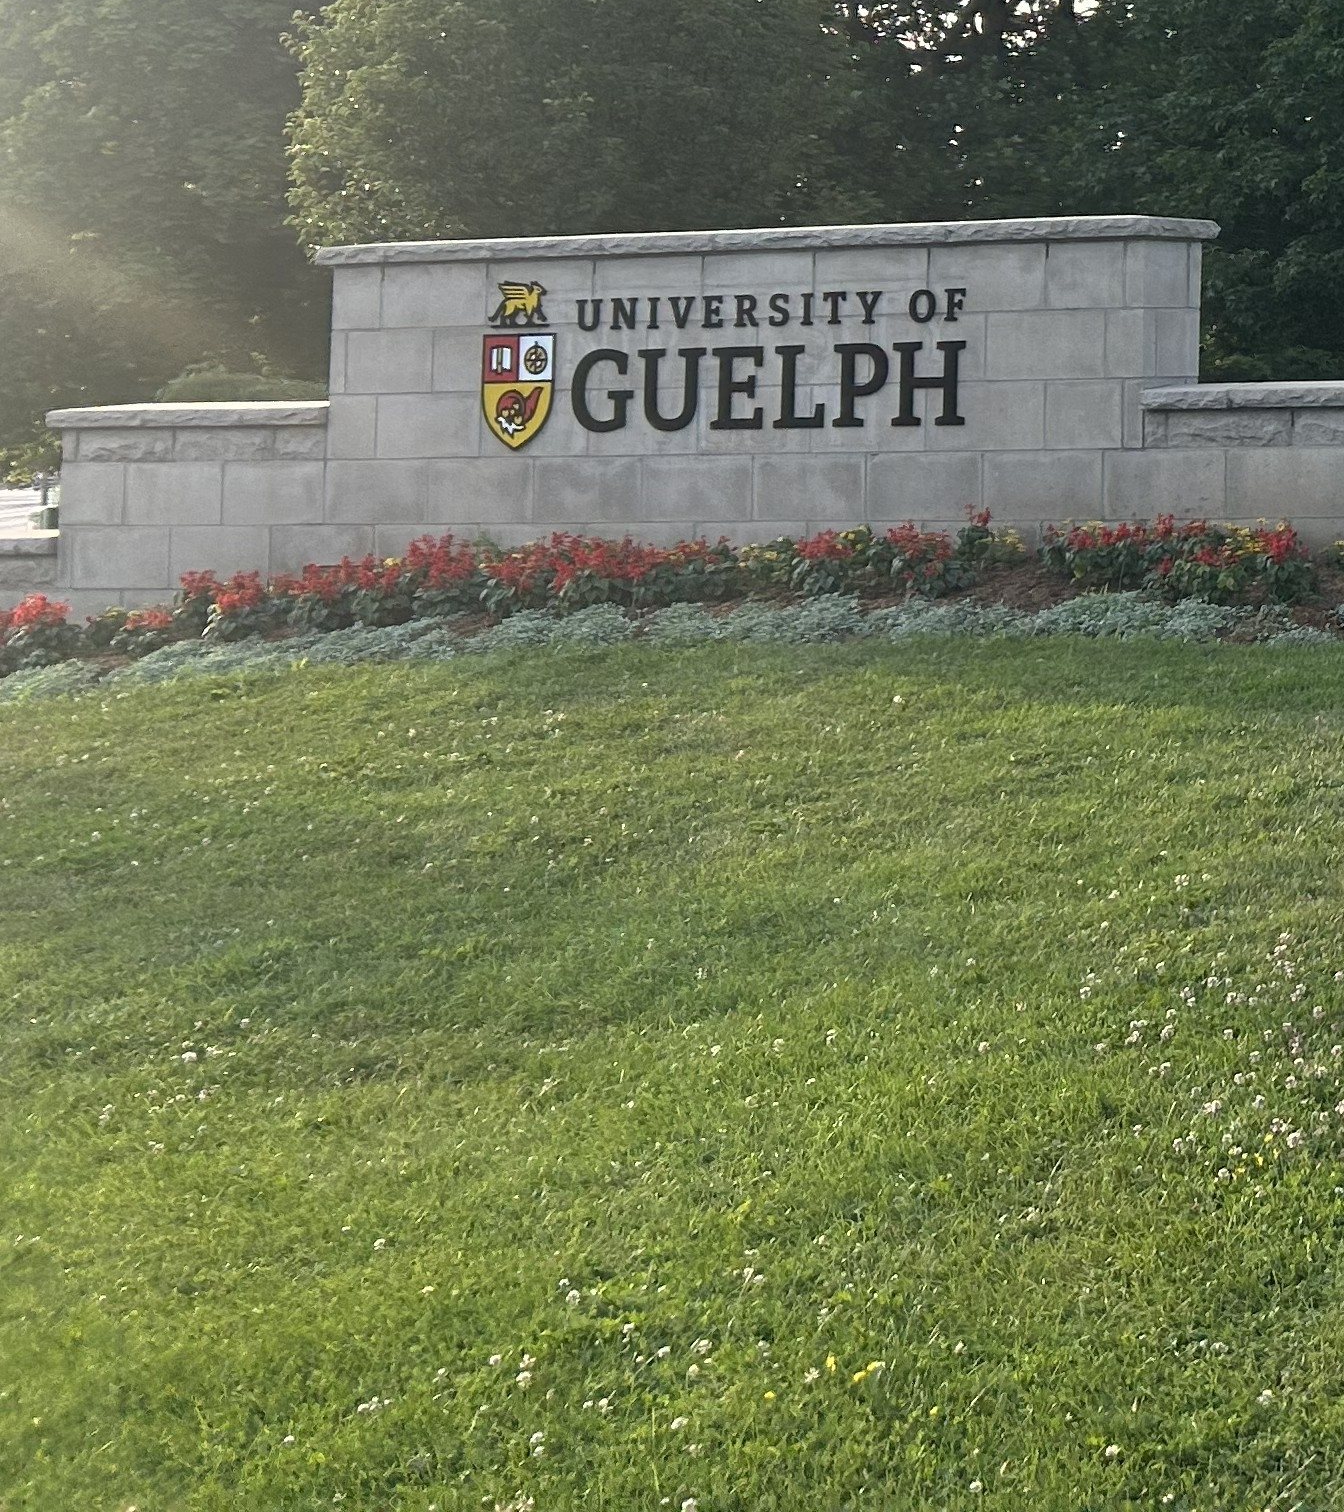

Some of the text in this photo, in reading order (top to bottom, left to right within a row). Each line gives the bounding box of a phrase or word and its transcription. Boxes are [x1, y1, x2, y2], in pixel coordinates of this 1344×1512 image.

[575, 288, 967, 331] UNIVERSITY OF
[571, 340, 967, 433] GUELPH
